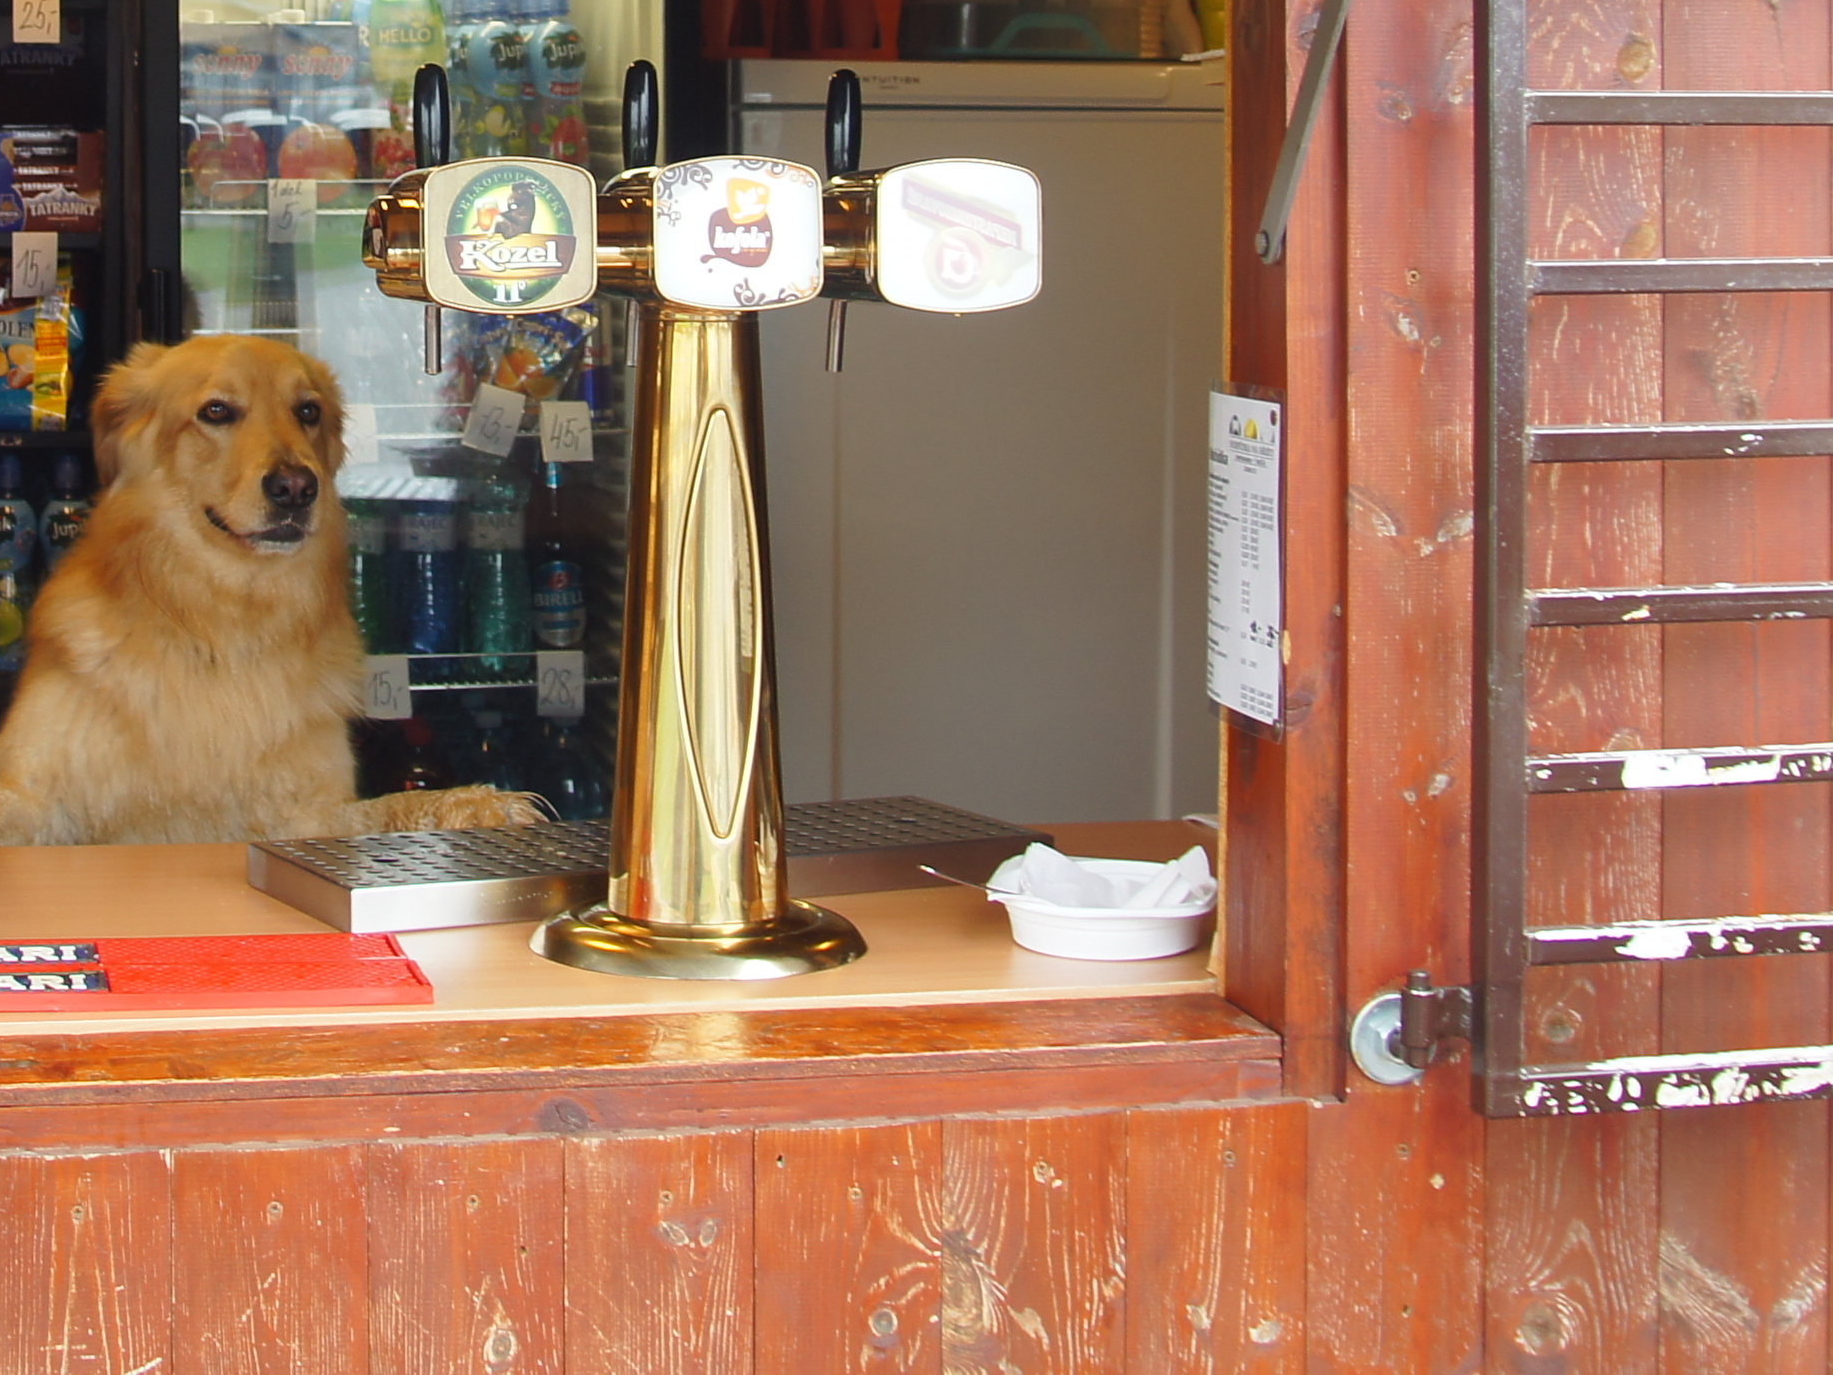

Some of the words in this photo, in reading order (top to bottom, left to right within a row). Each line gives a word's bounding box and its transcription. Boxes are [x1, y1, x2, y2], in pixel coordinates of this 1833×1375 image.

[378, 27, 432, 44] HELLO
[498, 42, 526, 61] Jup
[550, 42, 579, 62] Jup
[29, 201, 98, 217] TATRANKY
[713, 226, 771, 254] kofola
[459, 239, 564, 272] Kozel
